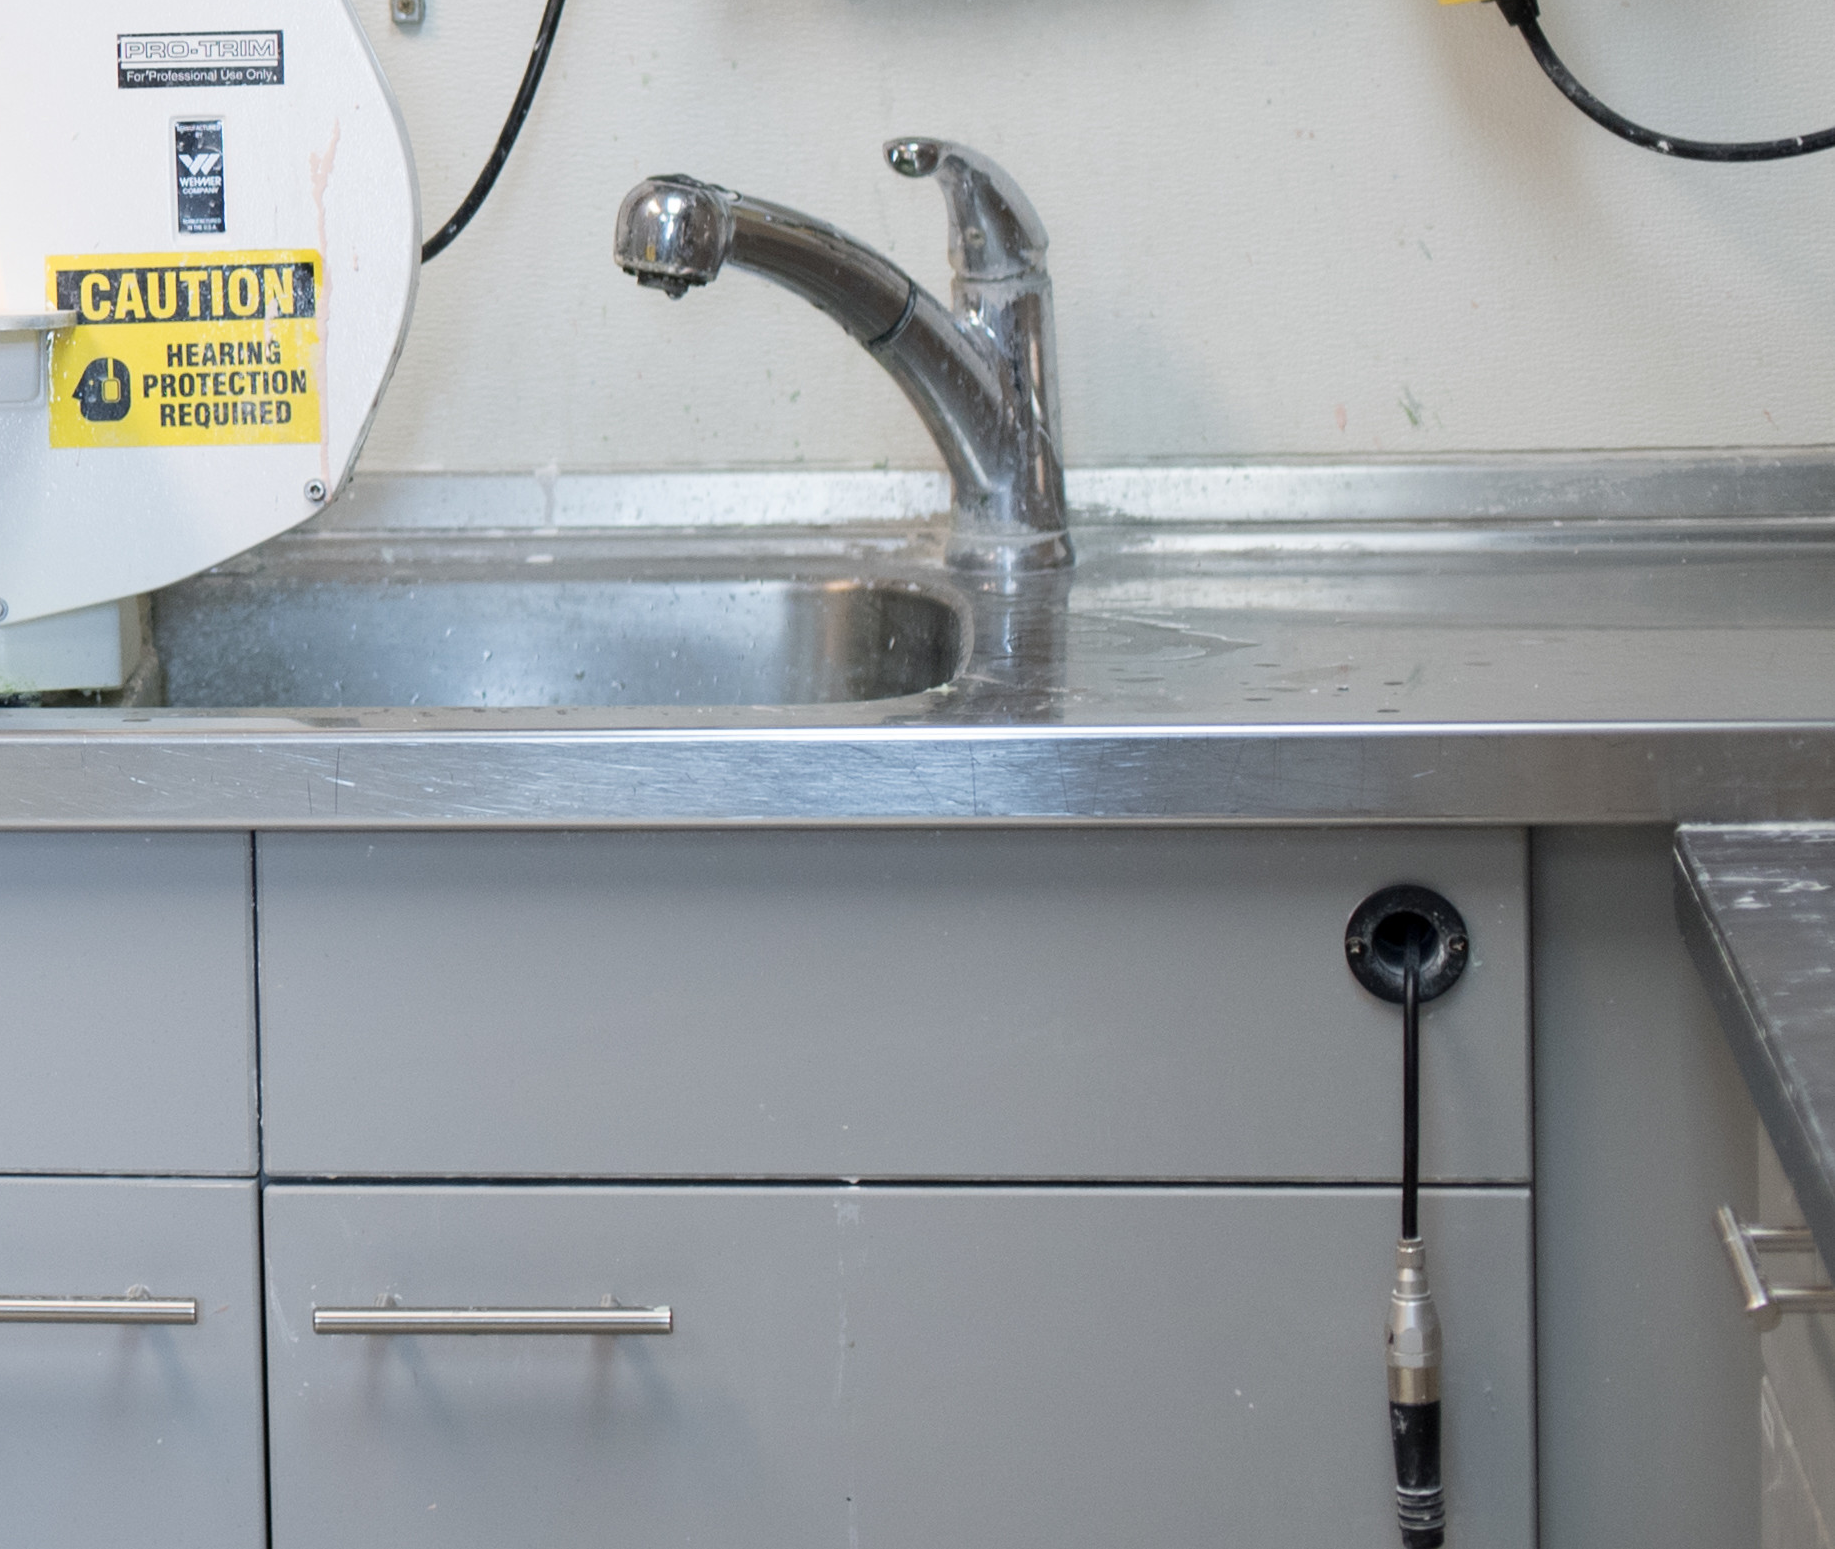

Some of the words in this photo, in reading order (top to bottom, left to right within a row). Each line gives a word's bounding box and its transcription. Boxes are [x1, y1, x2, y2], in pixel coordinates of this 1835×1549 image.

[125, 39, 275, 59] PRO-TRIM
[127, 71, 145, 82] For
[148, 70, 217, 82] Professional
[221, 69, 242, 80] Use
[179, 176, 221, 187] WEHMER
[80, 267, 294, 321] CAUTION
[167, 340, 280, 367] HEARING
[143, 370, 307, 398] PROTECTION
[160, 401, 292, 429] REQUIRED
